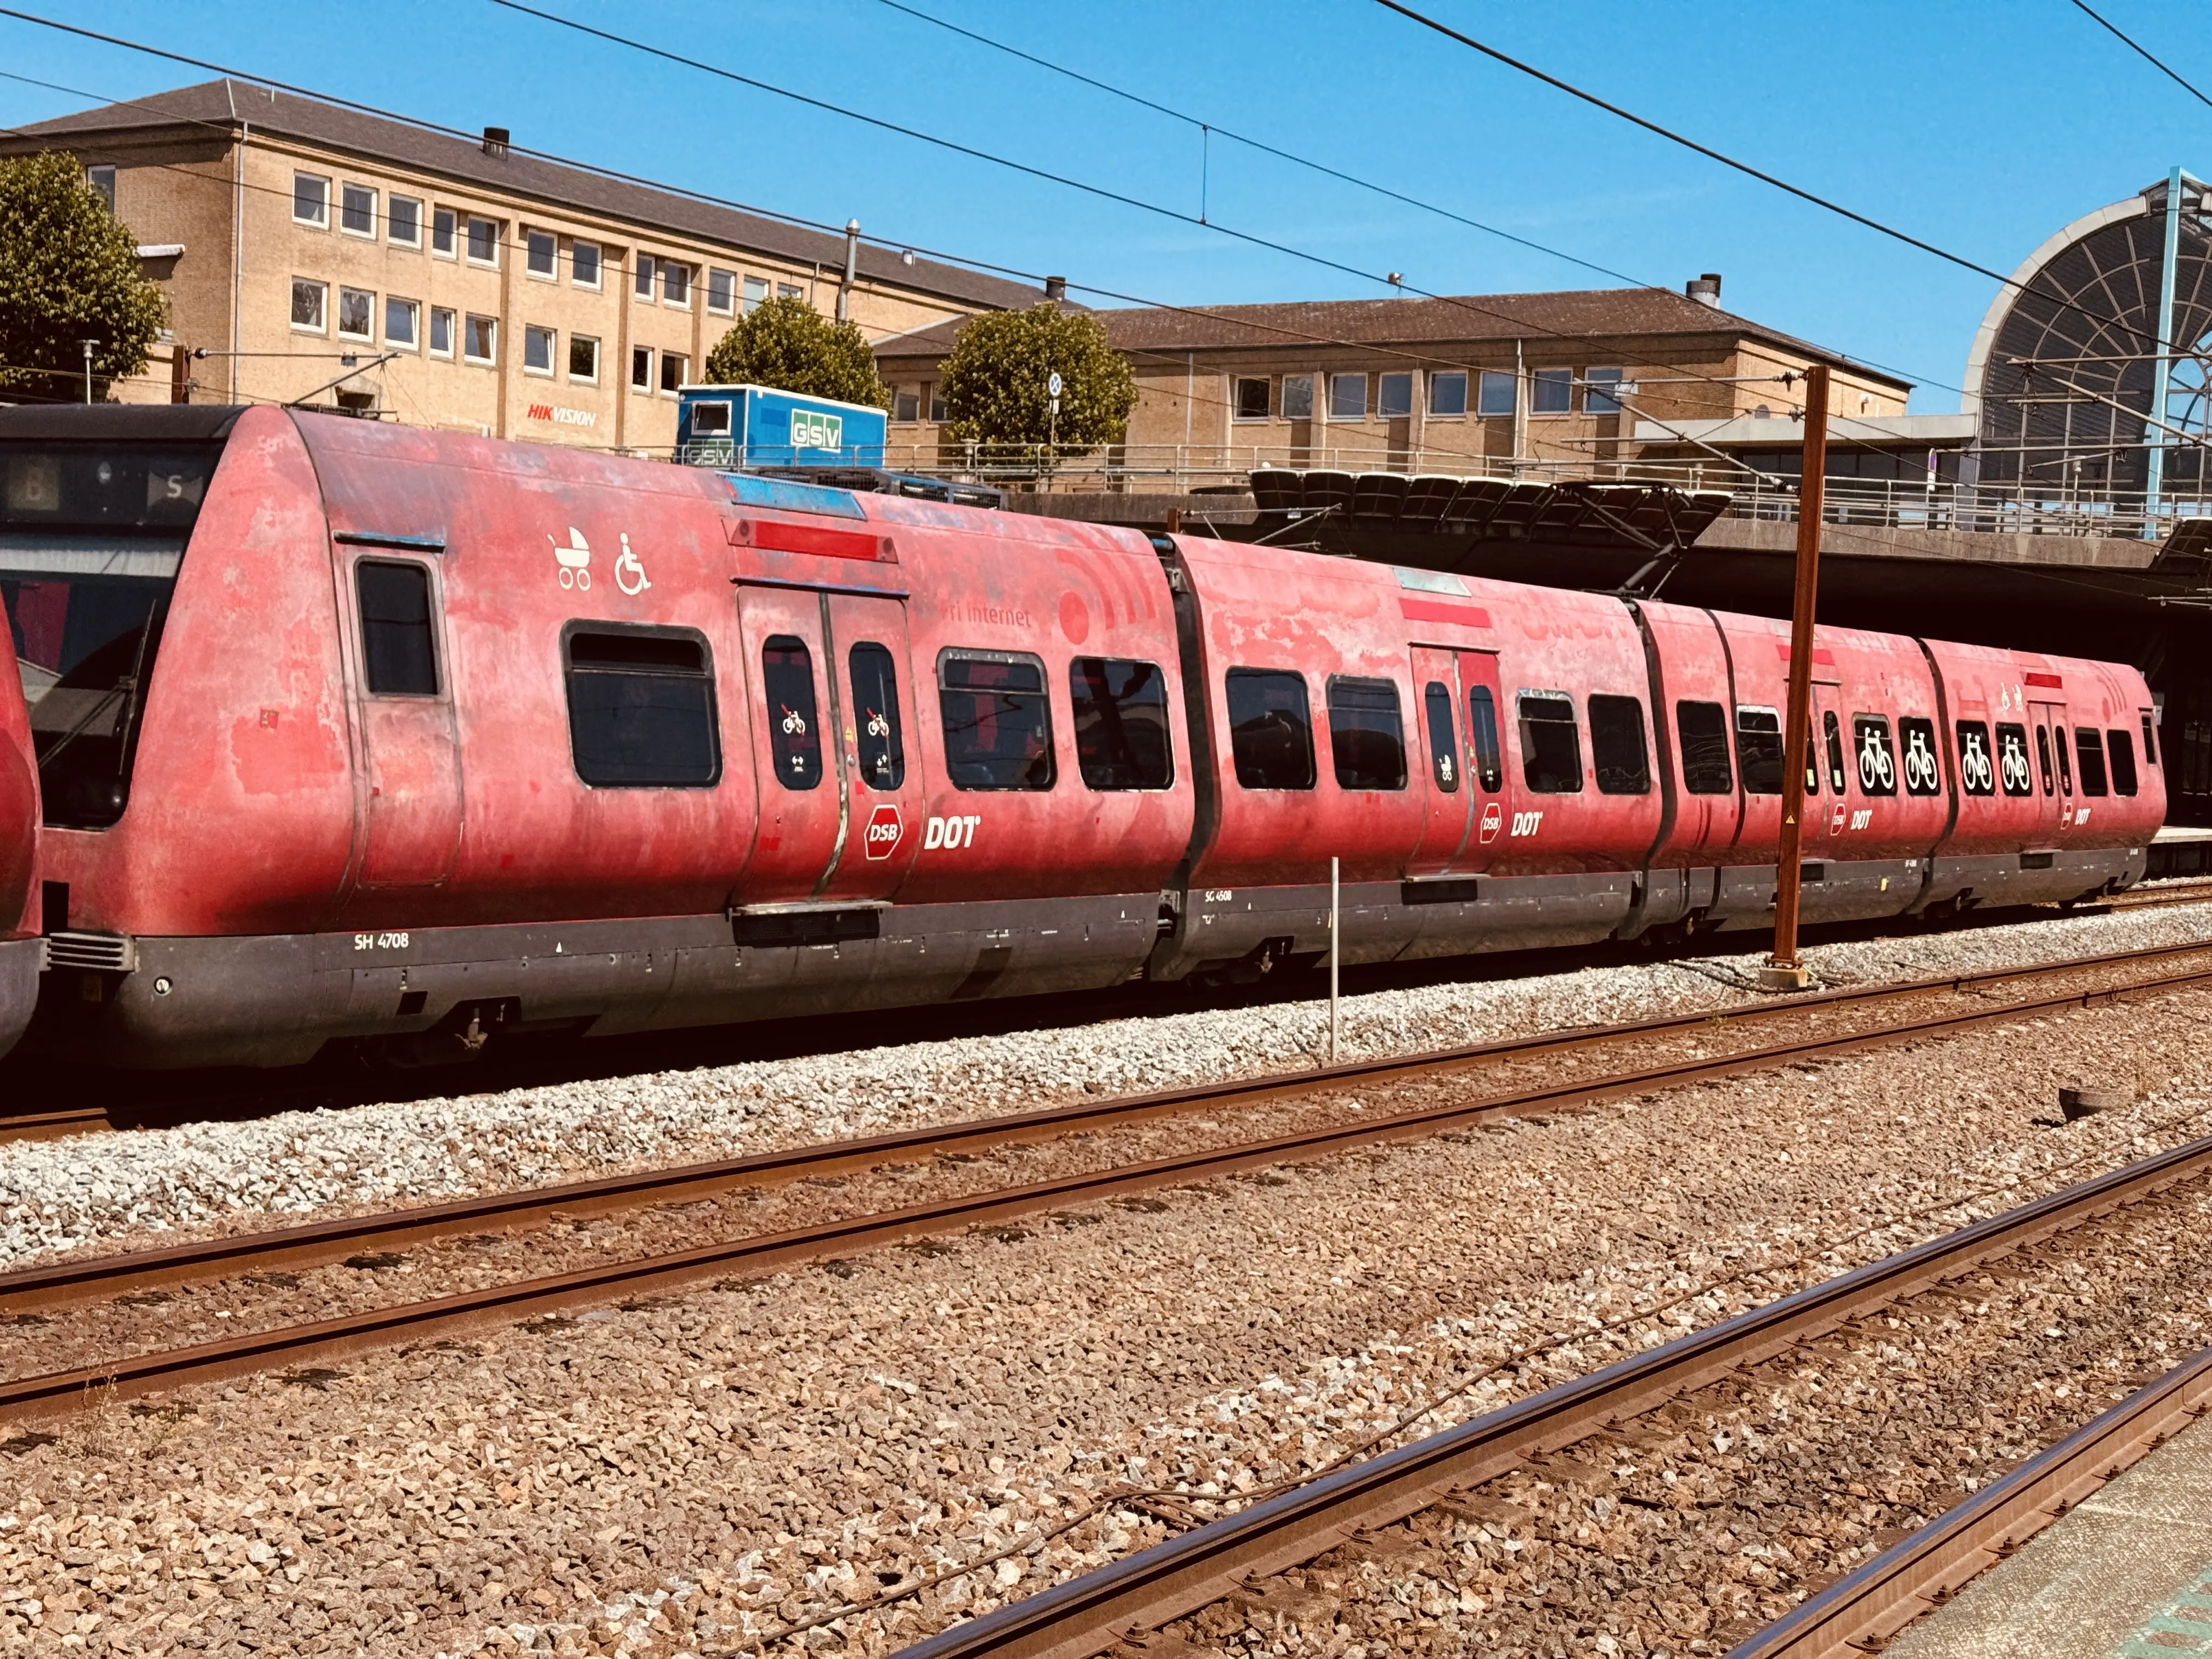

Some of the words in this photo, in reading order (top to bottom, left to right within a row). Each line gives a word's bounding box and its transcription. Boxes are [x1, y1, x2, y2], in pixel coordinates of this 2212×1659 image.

[527, 403, 597, 427] HIKVISION
[794, 422, 838, 448] GSV
[688, 449, 732, 466] GSV
[166, 475, 182, 498] S
[967, 600, 1032, 628] Internet
[1483, 817, 1499, 830] DSB
[1510, 811, 1543, 837] DOT
[1850, 809, 1872, 830] DOT
[869, 823, 898, 842] DSB
[923, 815, 981, 850] DOT
[354, 934, 373, 950] SH
[377, 932, 409, 949] 4708
